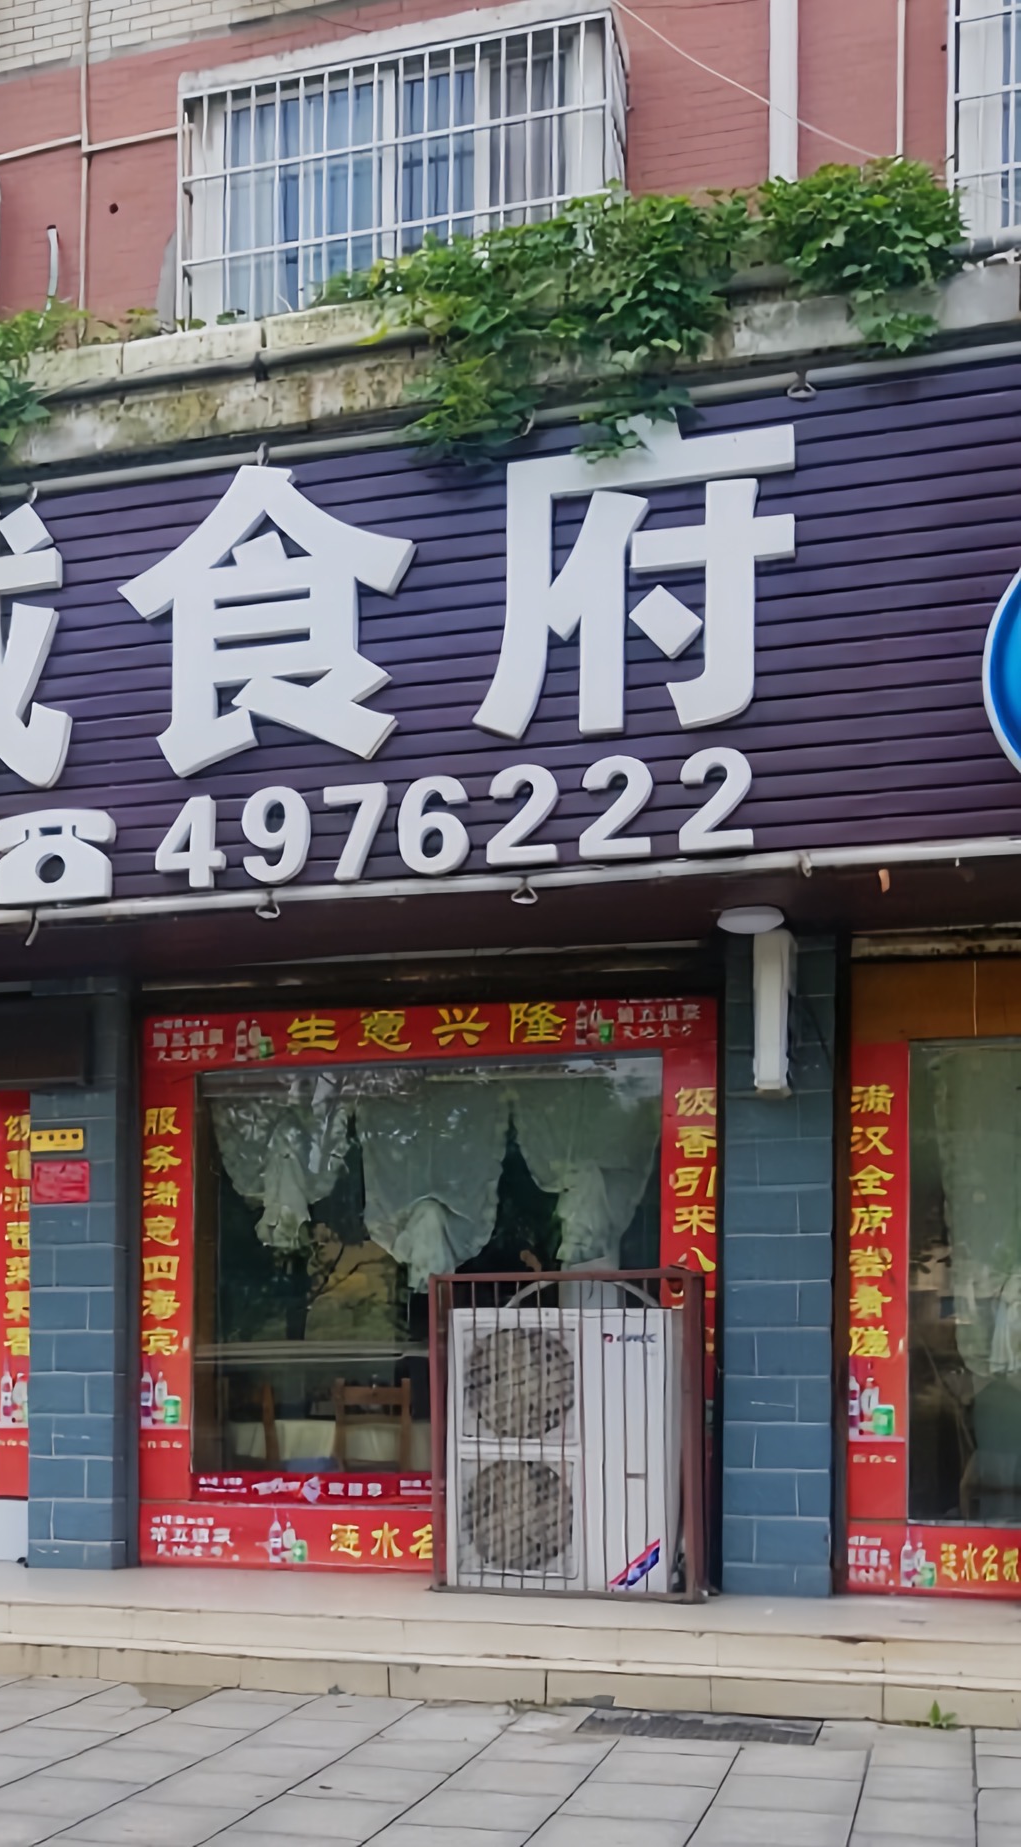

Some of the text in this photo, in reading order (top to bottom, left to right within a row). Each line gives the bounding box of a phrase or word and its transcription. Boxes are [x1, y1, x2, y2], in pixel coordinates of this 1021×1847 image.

[154, 747, 755, 889] 4976222
[287, 1002, 566, 1055] 生意兴隆
[142, 1106, 182, 1356] 服务满意四海宾
